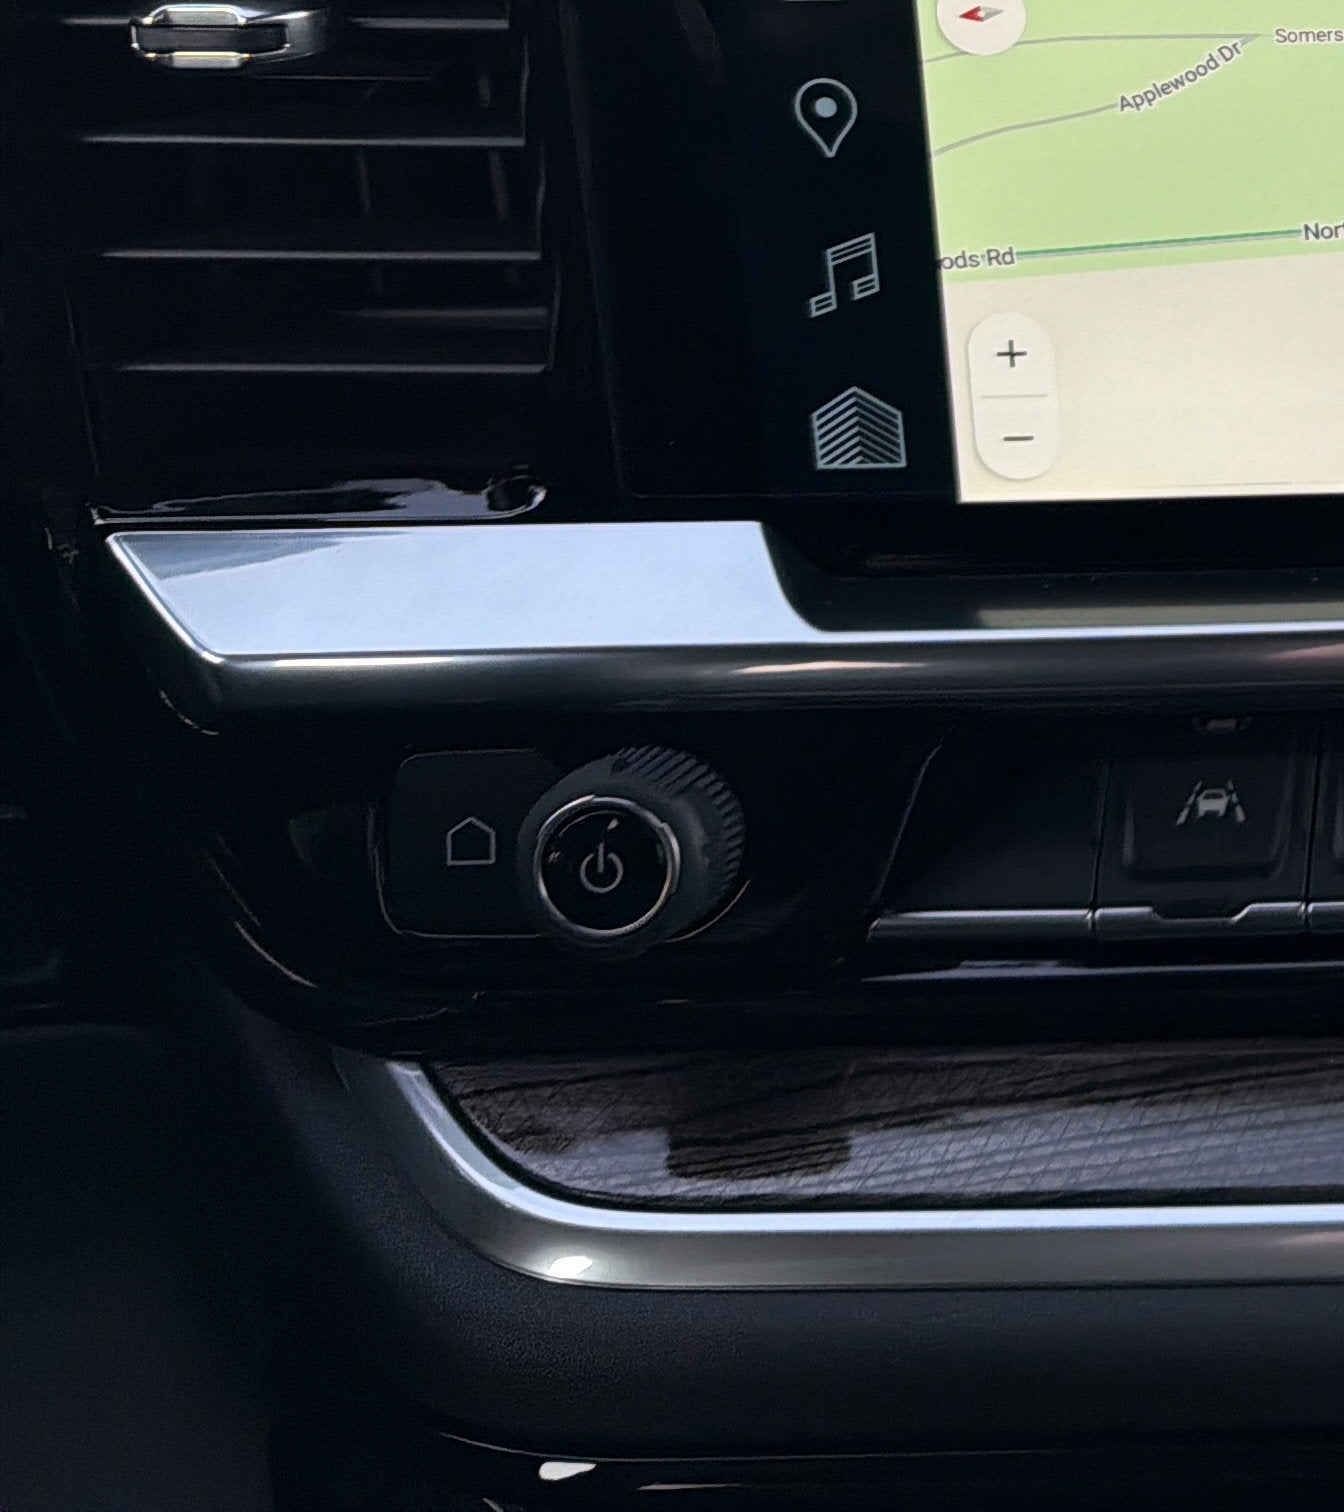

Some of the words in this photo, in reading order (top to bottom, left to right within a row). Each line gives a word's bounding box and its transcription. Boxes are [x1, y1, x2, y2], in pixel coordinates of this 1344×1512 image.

[1274, 26, 1344, 45] Somers
[1119, 52, 1221, 112] Applewood
[1216, 41, 1242, 63] Dr
[986, 246, 1015, 267] Rd
